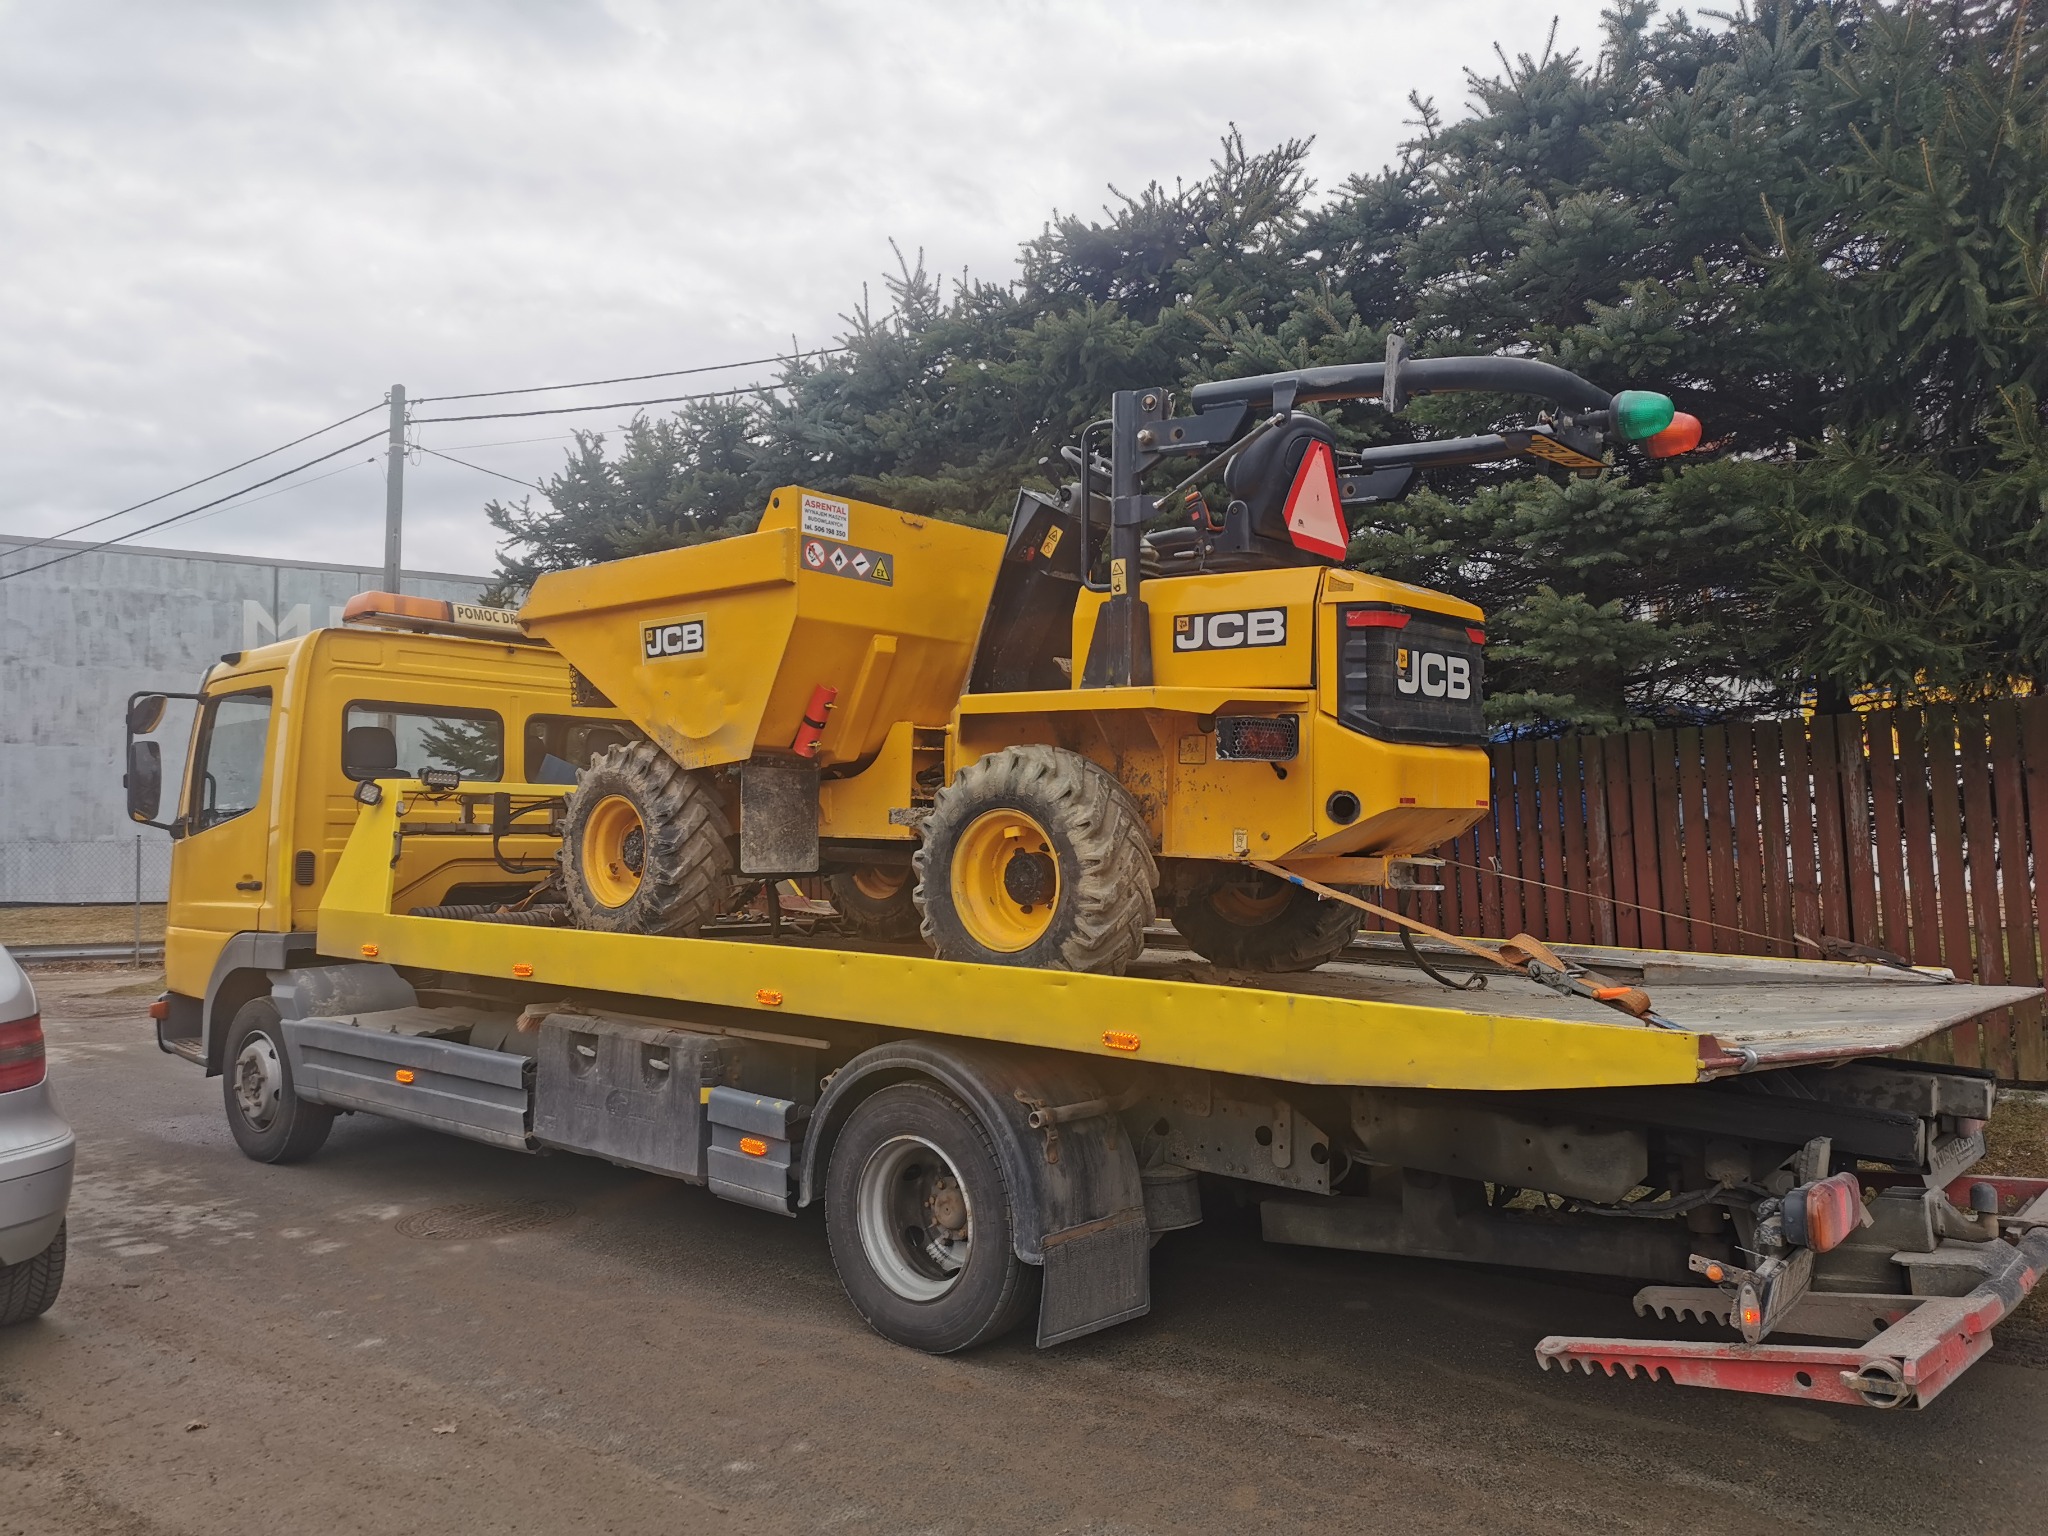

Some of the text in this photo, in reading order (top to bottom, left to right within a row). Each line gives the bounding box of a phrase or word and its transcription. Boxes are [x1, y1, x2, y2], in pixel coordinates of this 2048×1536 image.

[804, 499, 847, 515] ASRENTAL
[804, 508, 847, 522] WYNAJEM MASZYN
[807, 515, 844, 528] BUDOWLANYCH
[877, 568, 885, 577] EX
[457, 606, 500, 623] POMOC
[1176, 610, 1285, 650] JCB
[646, 623, 703, 656] JCB
[1397, 650, 1471, 700] JCB
